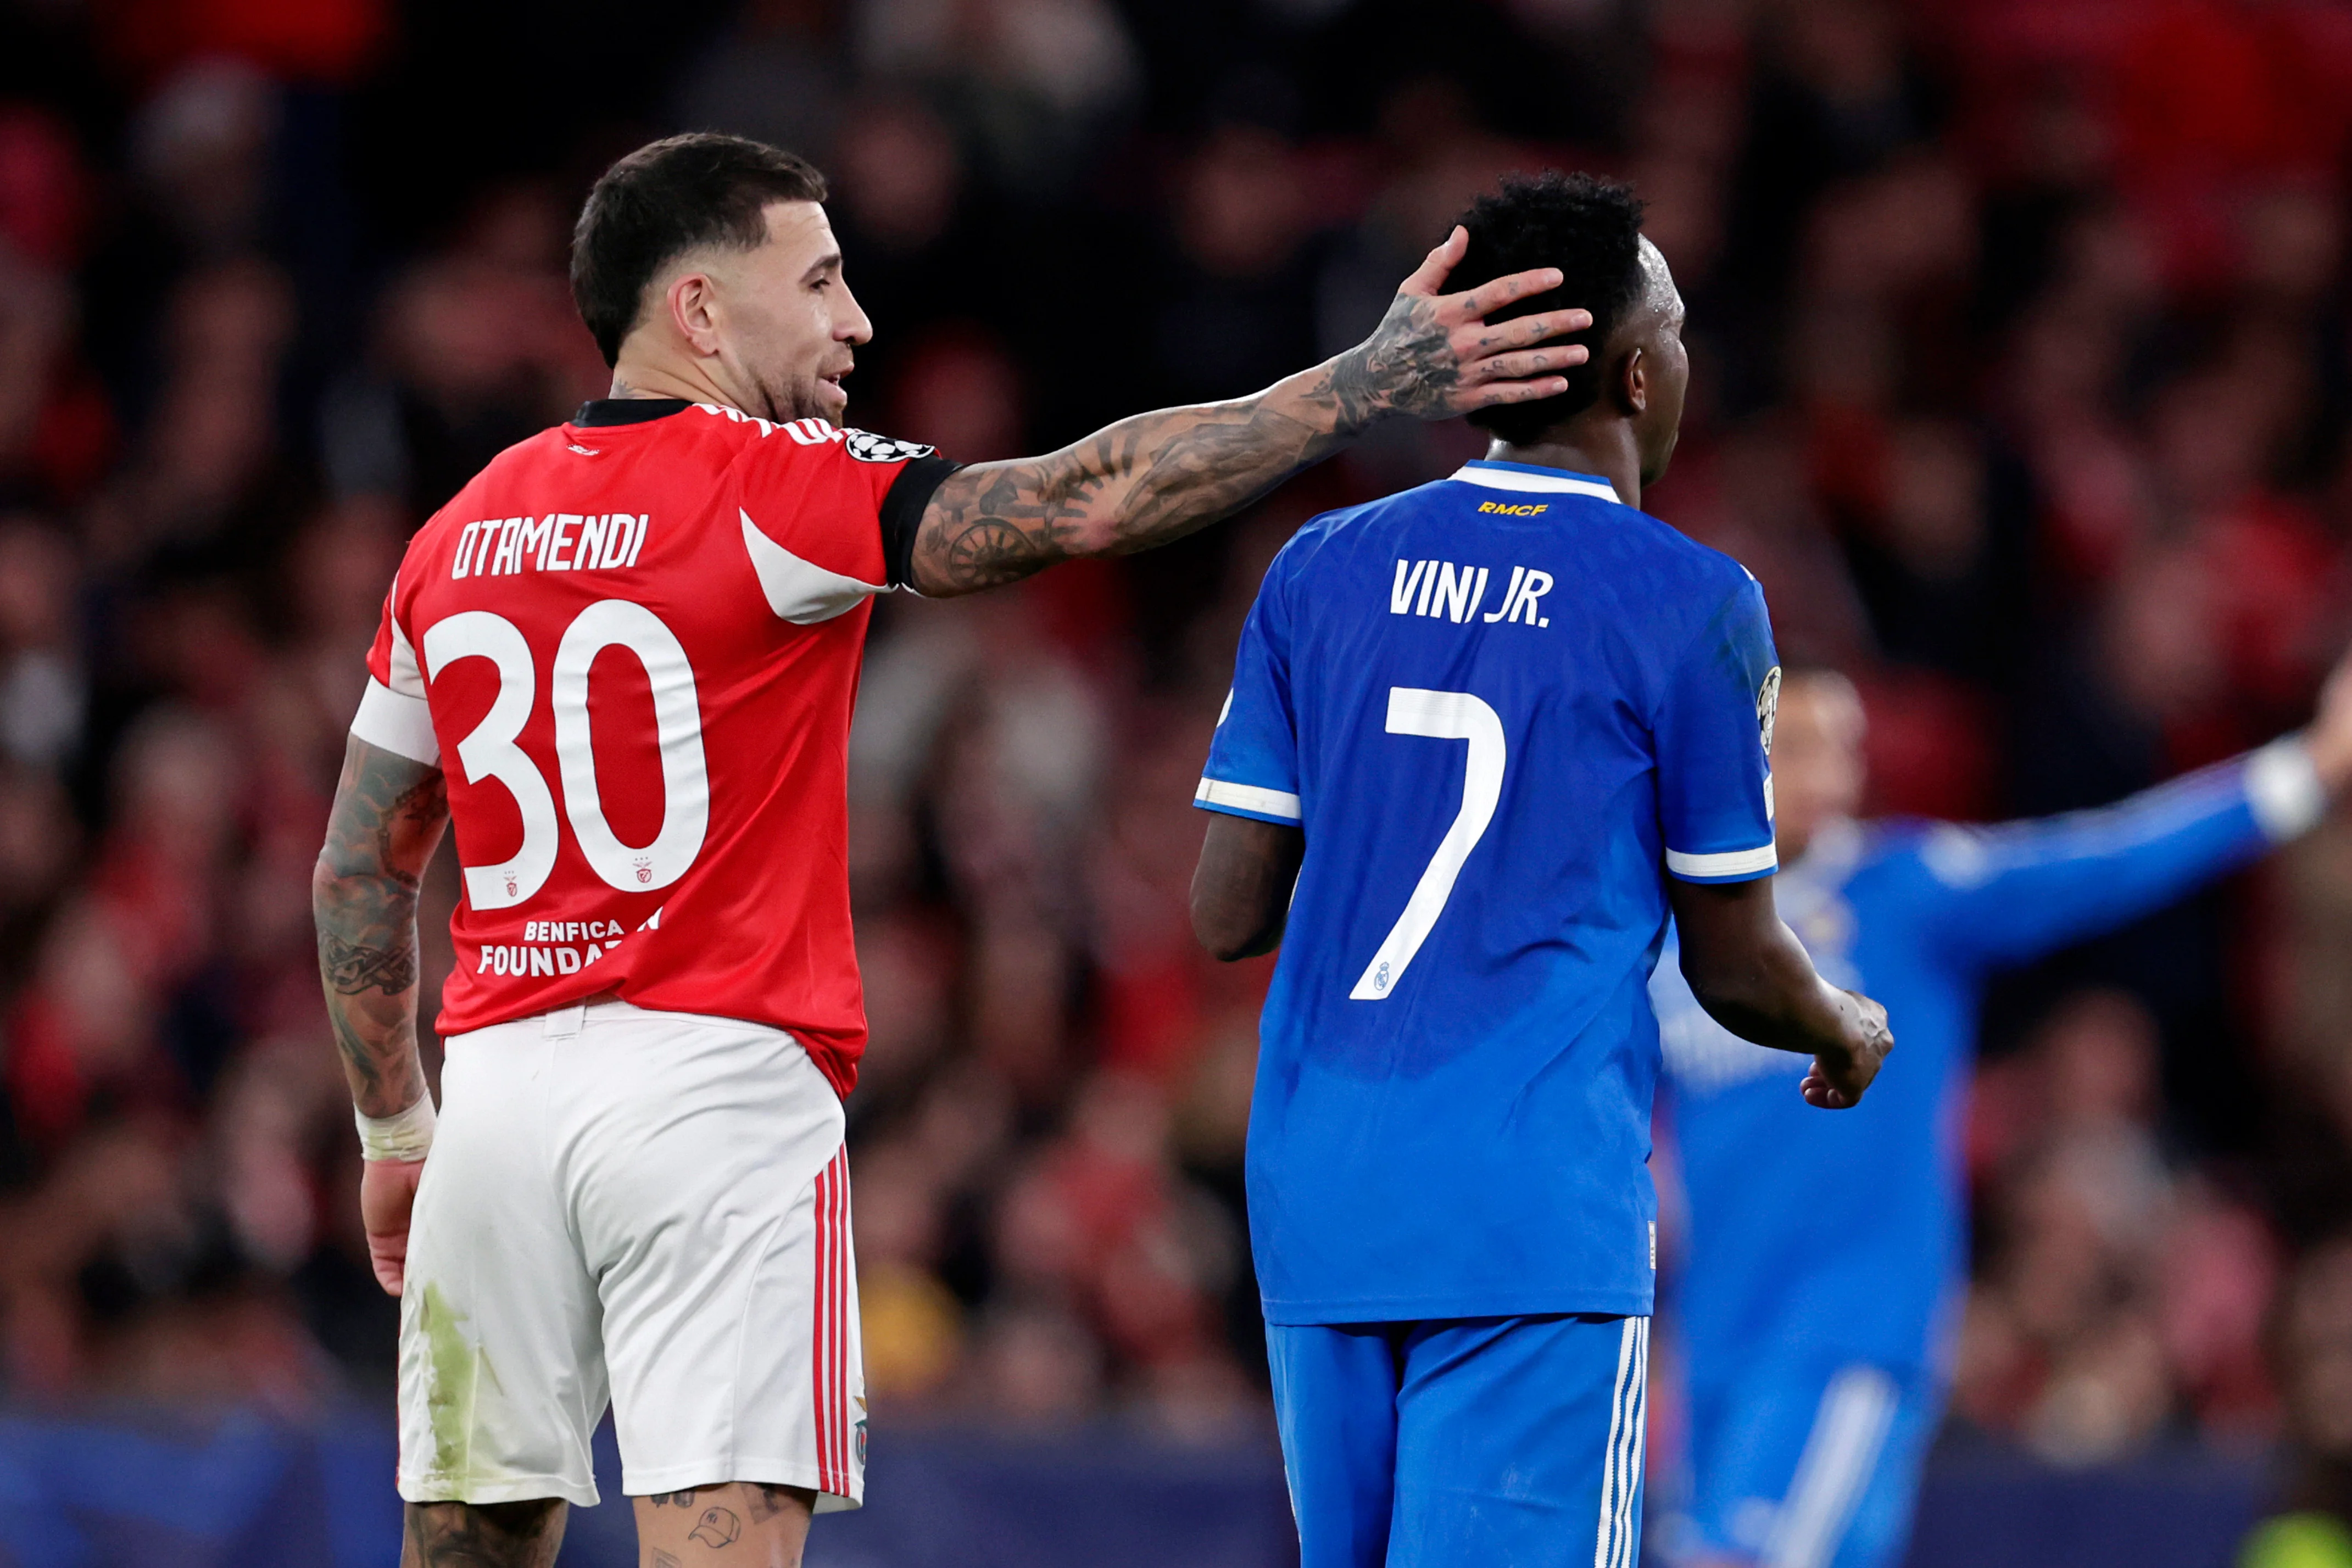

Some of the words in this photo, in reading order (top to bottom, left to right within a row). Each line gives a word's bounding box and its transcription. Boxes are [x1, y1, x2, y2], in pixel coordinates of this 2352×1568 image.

[1478, 501, 1549, 516] RMCF
[452, 514, 649, 580] OTAMENDI
[1390, 559, 1489, 623] VINI
[1484, 566, 1553, 628] JR.
[423, 599, 709, 911] 30
[1349, 687, 1506, 1000] 7
[523, 919, 625, 942] BENFICA
